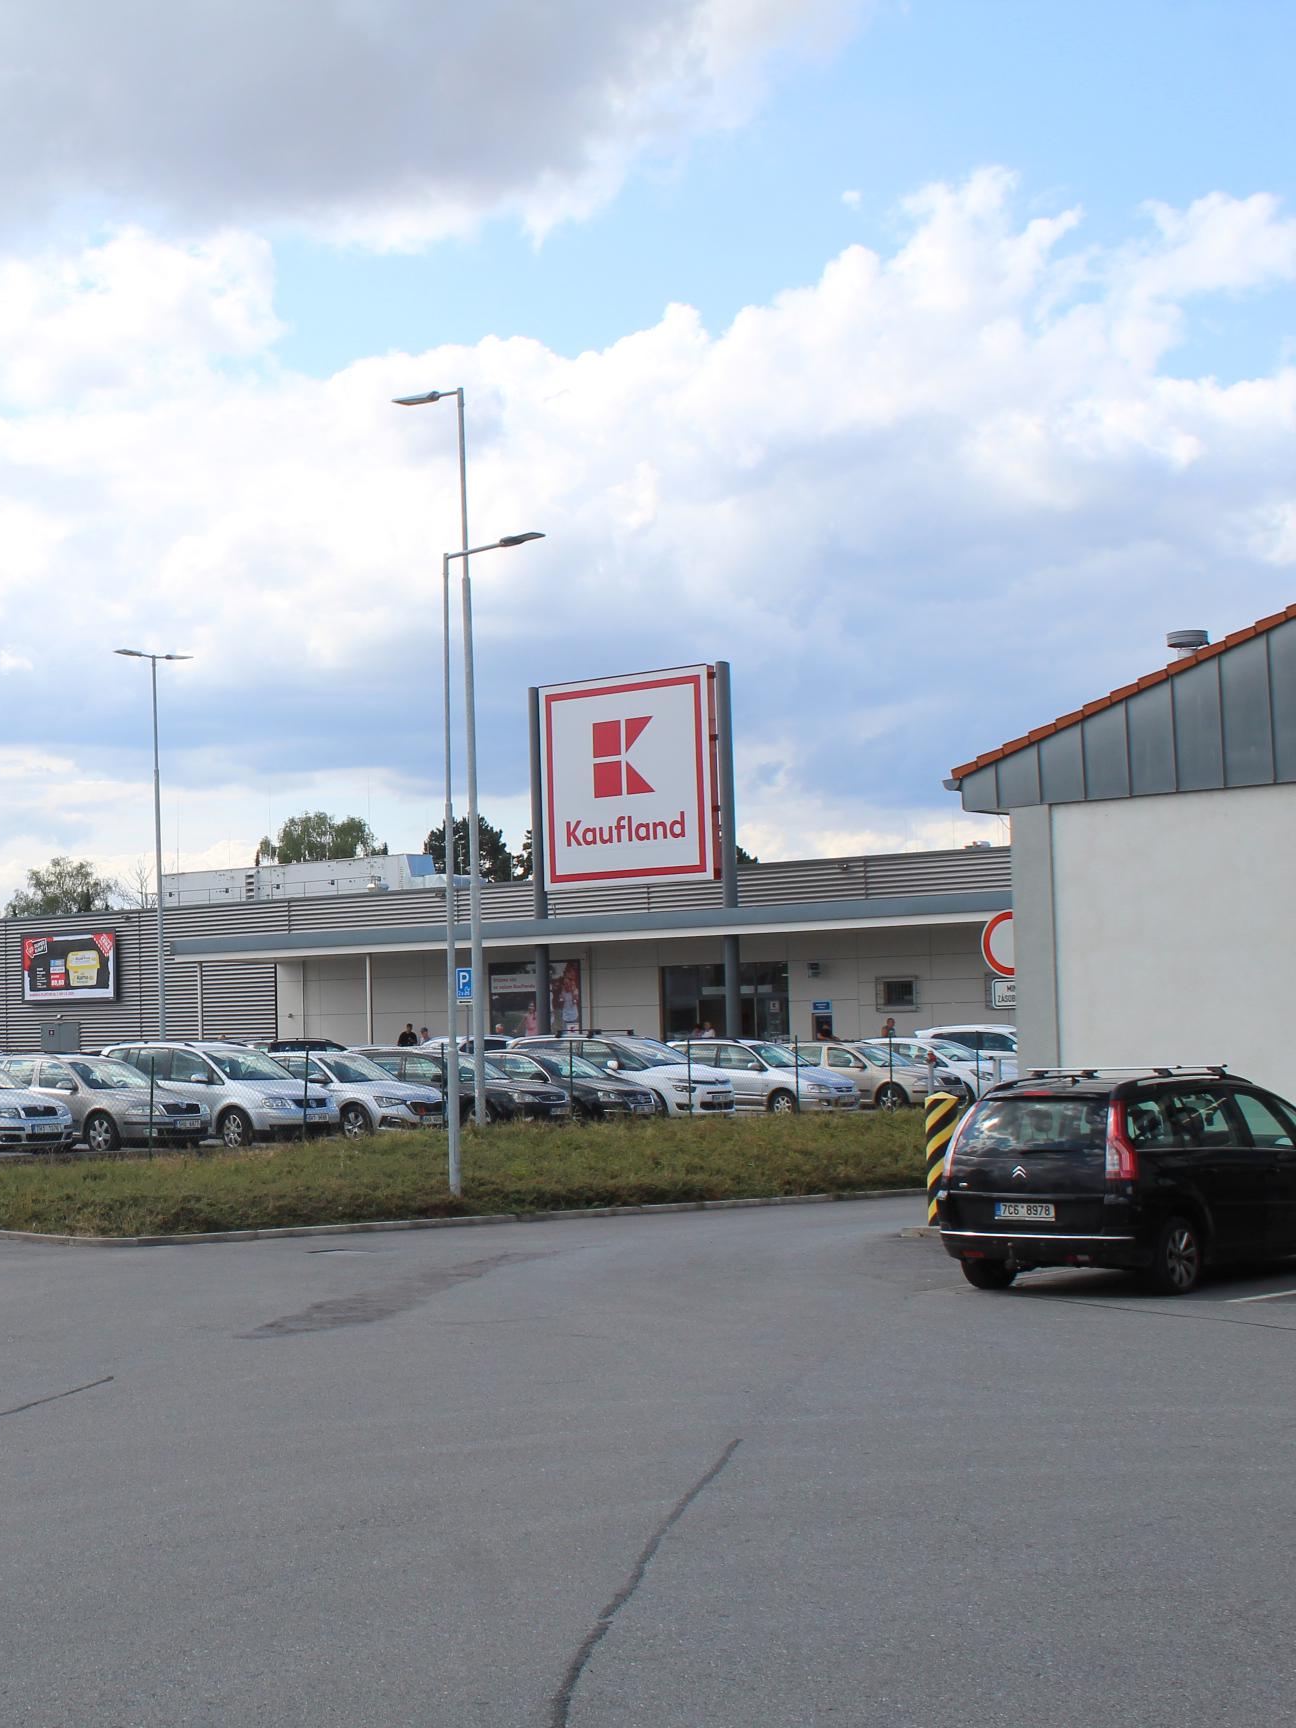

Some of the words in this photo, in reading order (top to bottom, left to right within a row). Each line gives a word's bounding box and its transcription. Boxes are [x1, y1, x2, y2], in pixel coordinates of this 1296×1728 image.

[565, 810, 686, 848] Kaufland
[459, 972, 469, 989] P
[1002, 1204, 1020, 1216] 7C6
[1026, 1205, 1050, 1216] 8978
